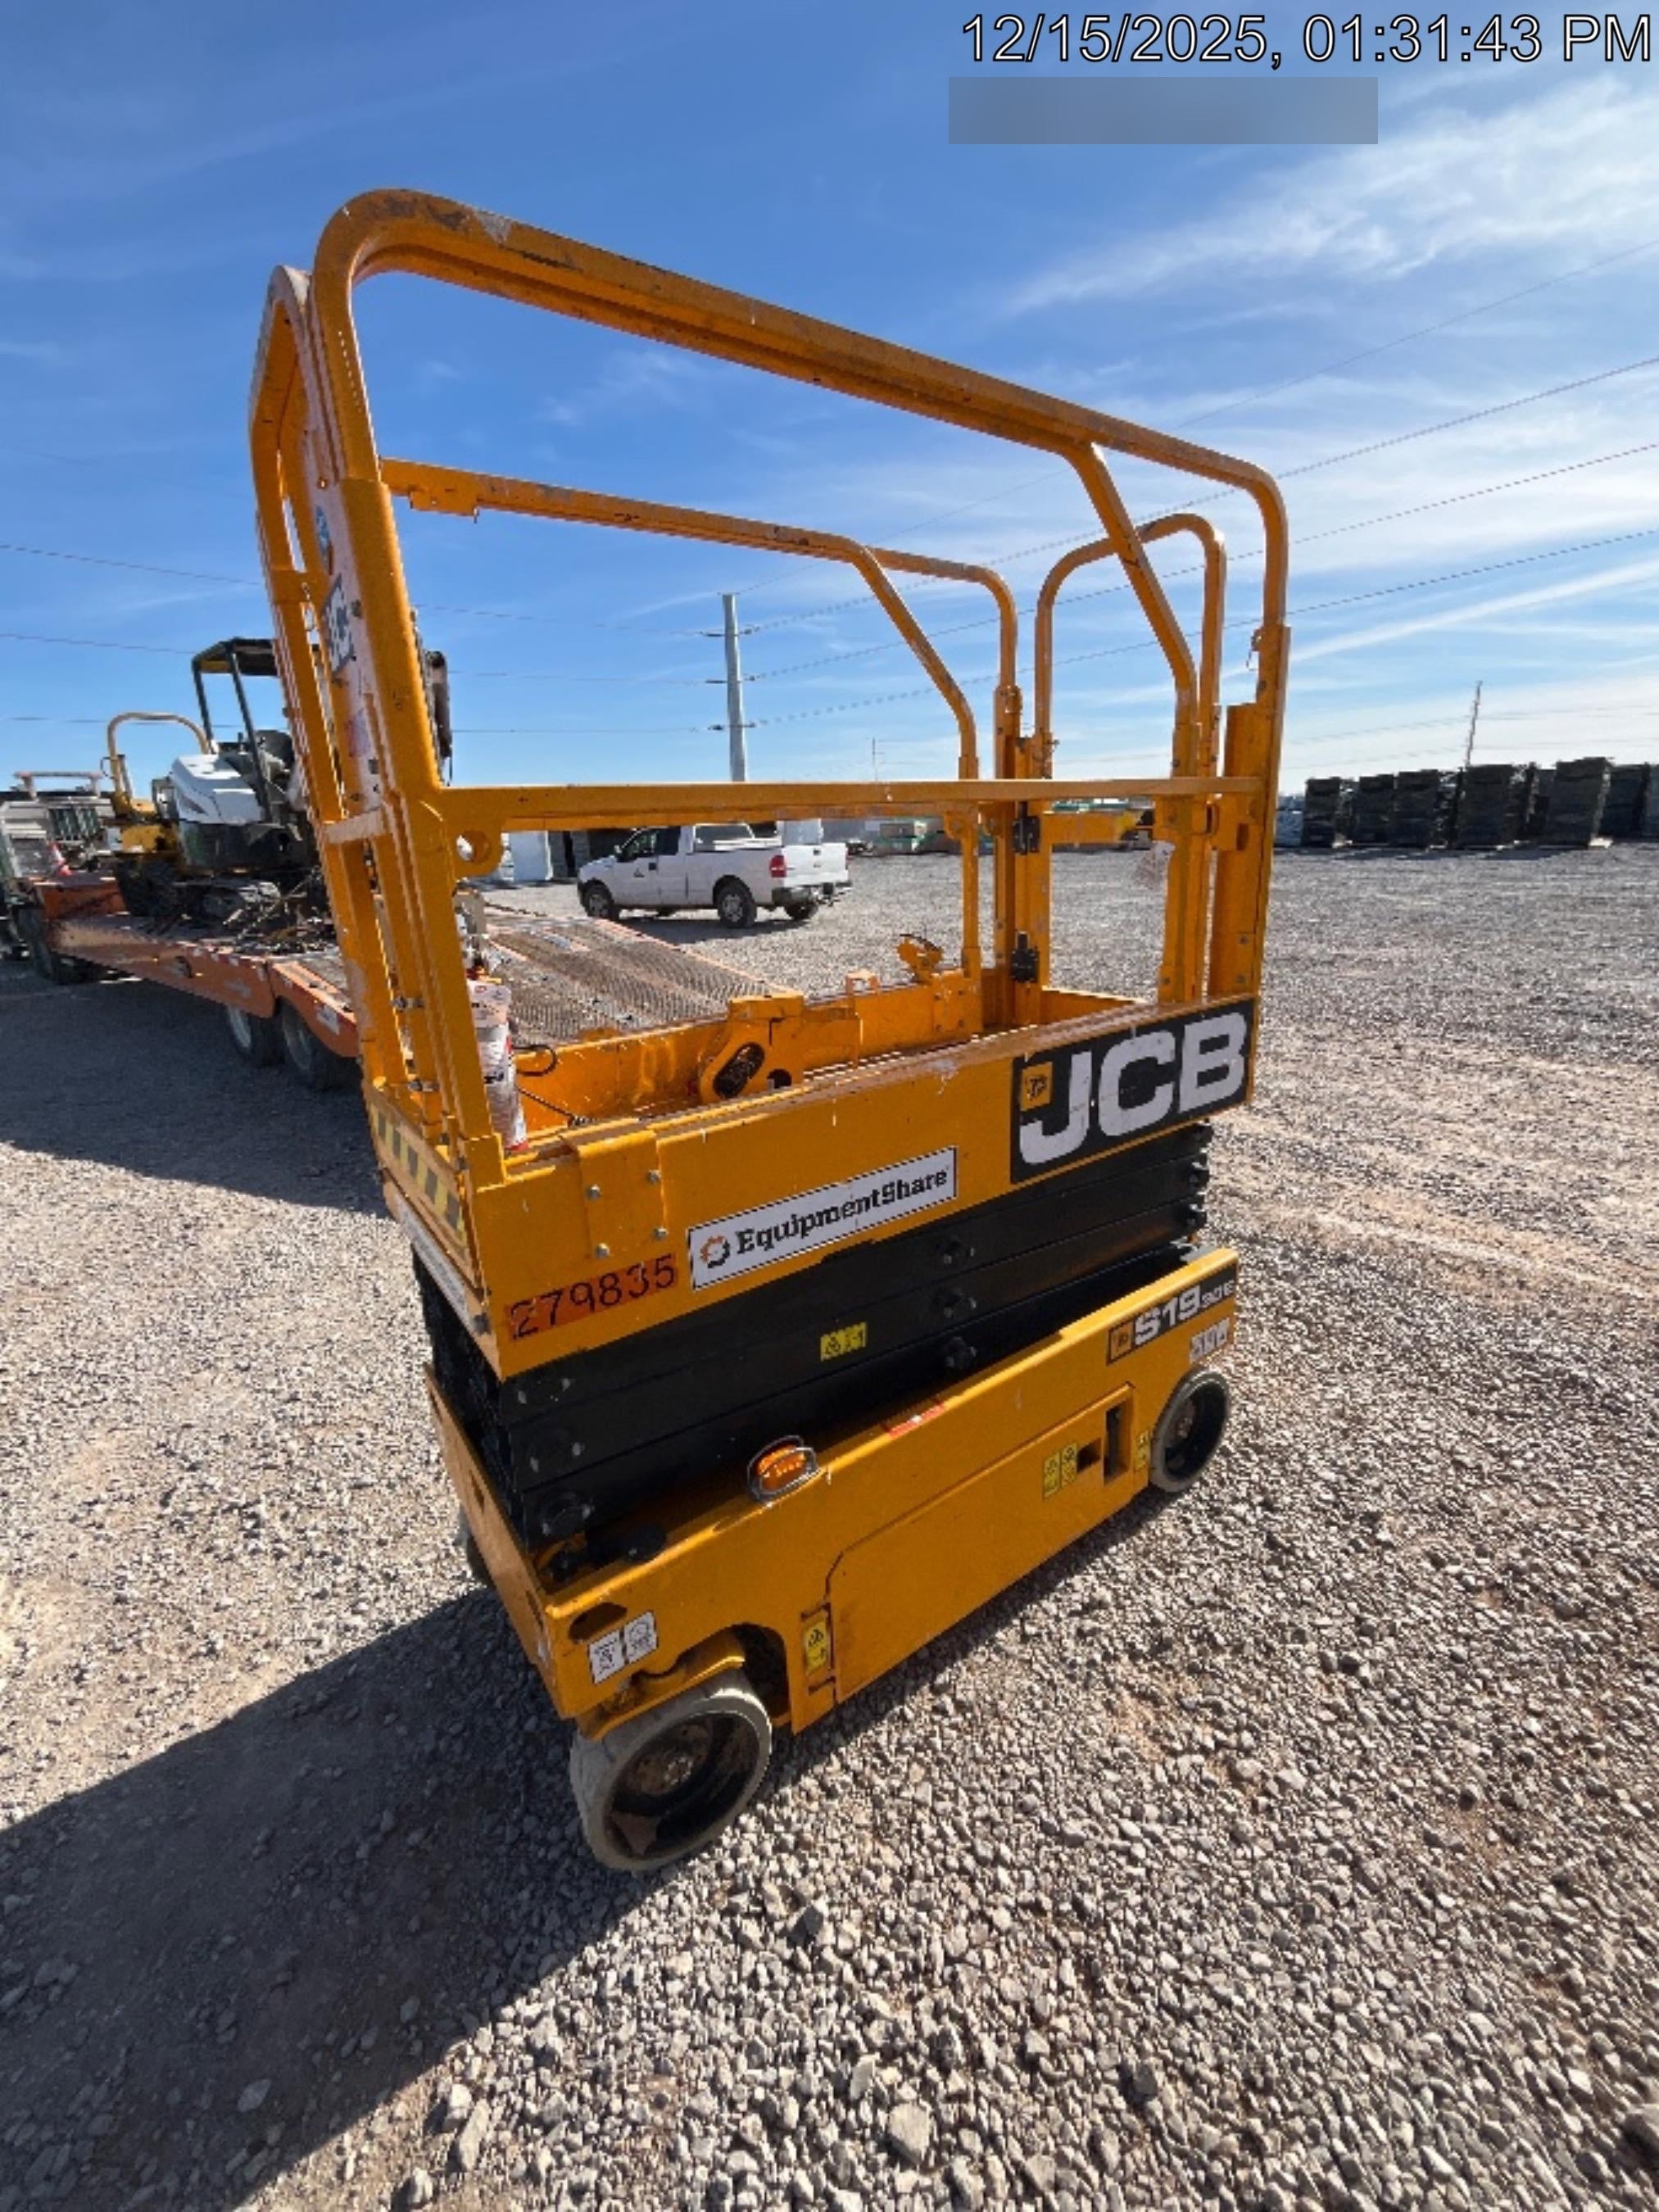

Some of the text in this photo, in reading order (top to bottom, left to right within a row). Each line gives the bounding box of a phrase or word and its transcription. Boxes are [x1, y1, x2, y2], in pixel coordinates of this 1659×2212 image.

[1019, 1012, 1247, 1164] JCB
[736, 1169, 948, 1254] EquipmentShare
[509, 1253, 676, 1340] 279835
